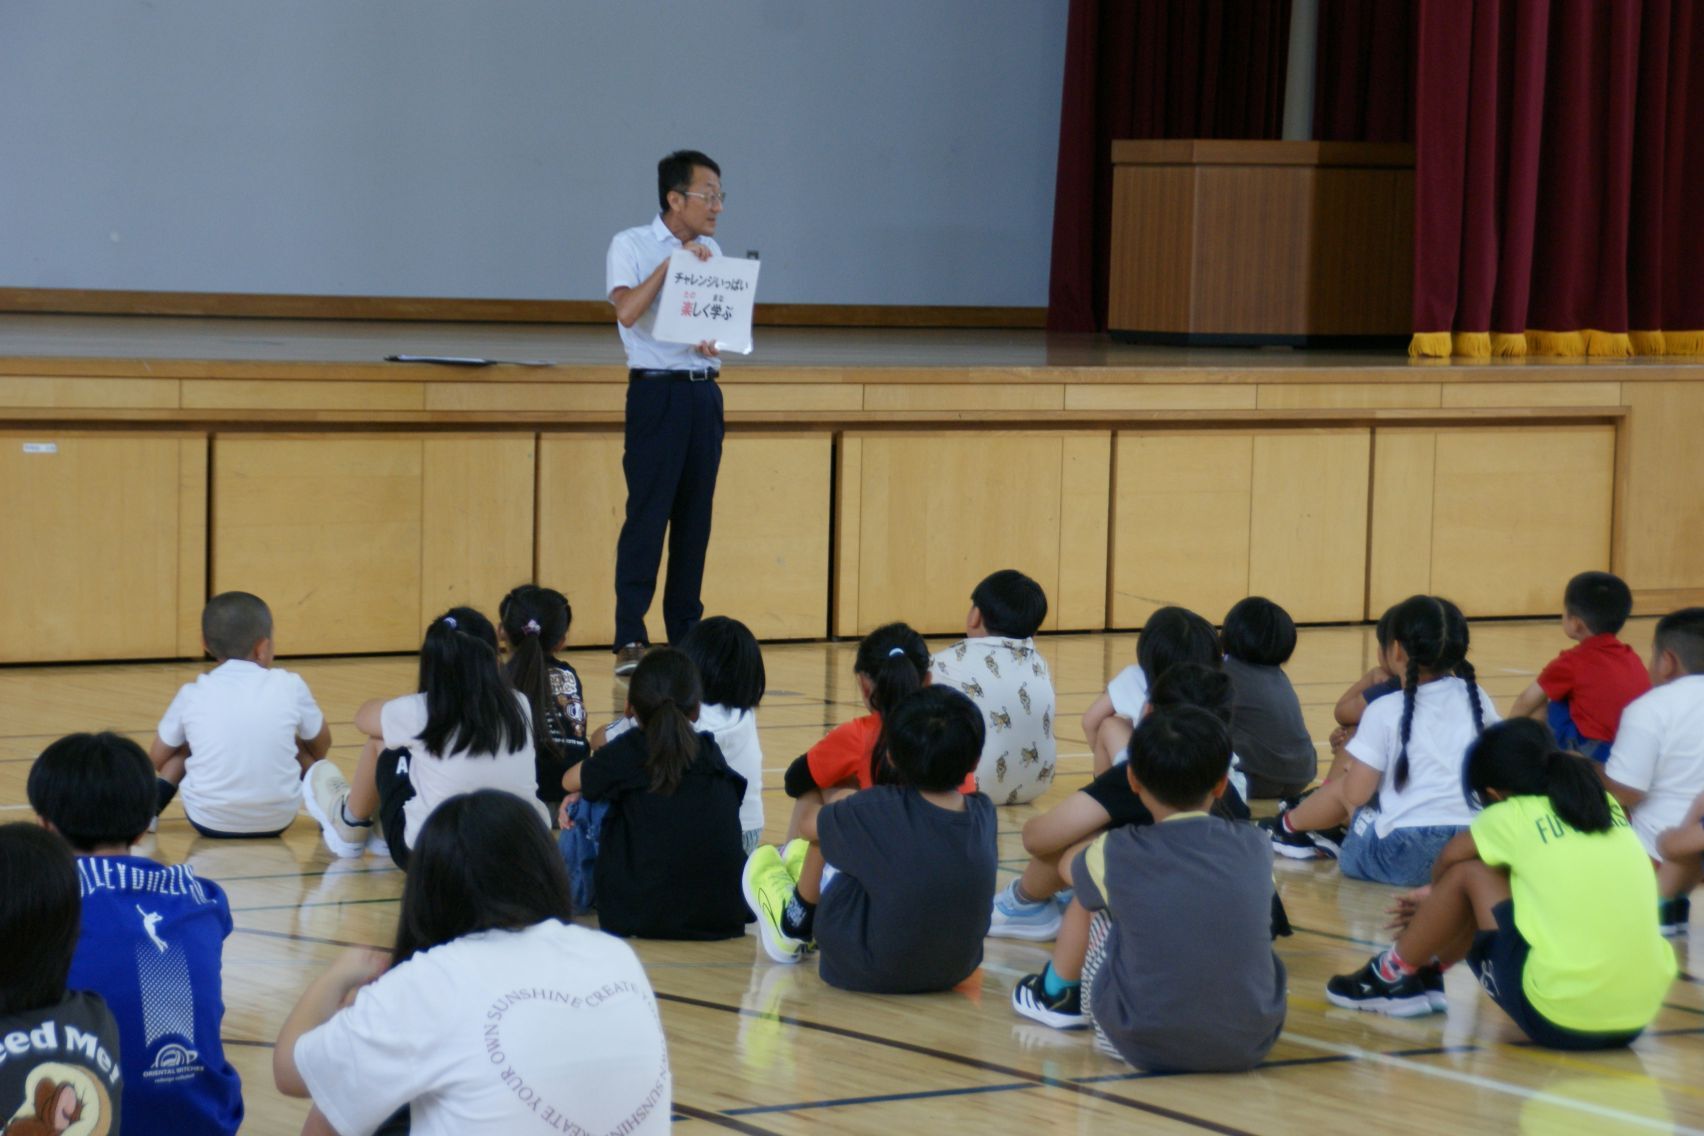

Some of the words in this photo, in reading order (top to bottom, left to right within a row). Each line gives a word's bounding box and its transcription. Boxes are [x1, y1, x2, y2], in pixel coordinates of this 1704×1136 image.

[674, 272, 749, 291] チャレンジいっぱい
[681, 301, 733, 320] 楽しく学ぶ
[487, 987, 583, 1021] SUNSHINE
[0, 1020, 58, 1063] ed
[484, 1023, 505, 1065] OWN
[500, 1066, 542, 1111] YOUR
[606, 1082, 664, 1136] SUNSHIN
